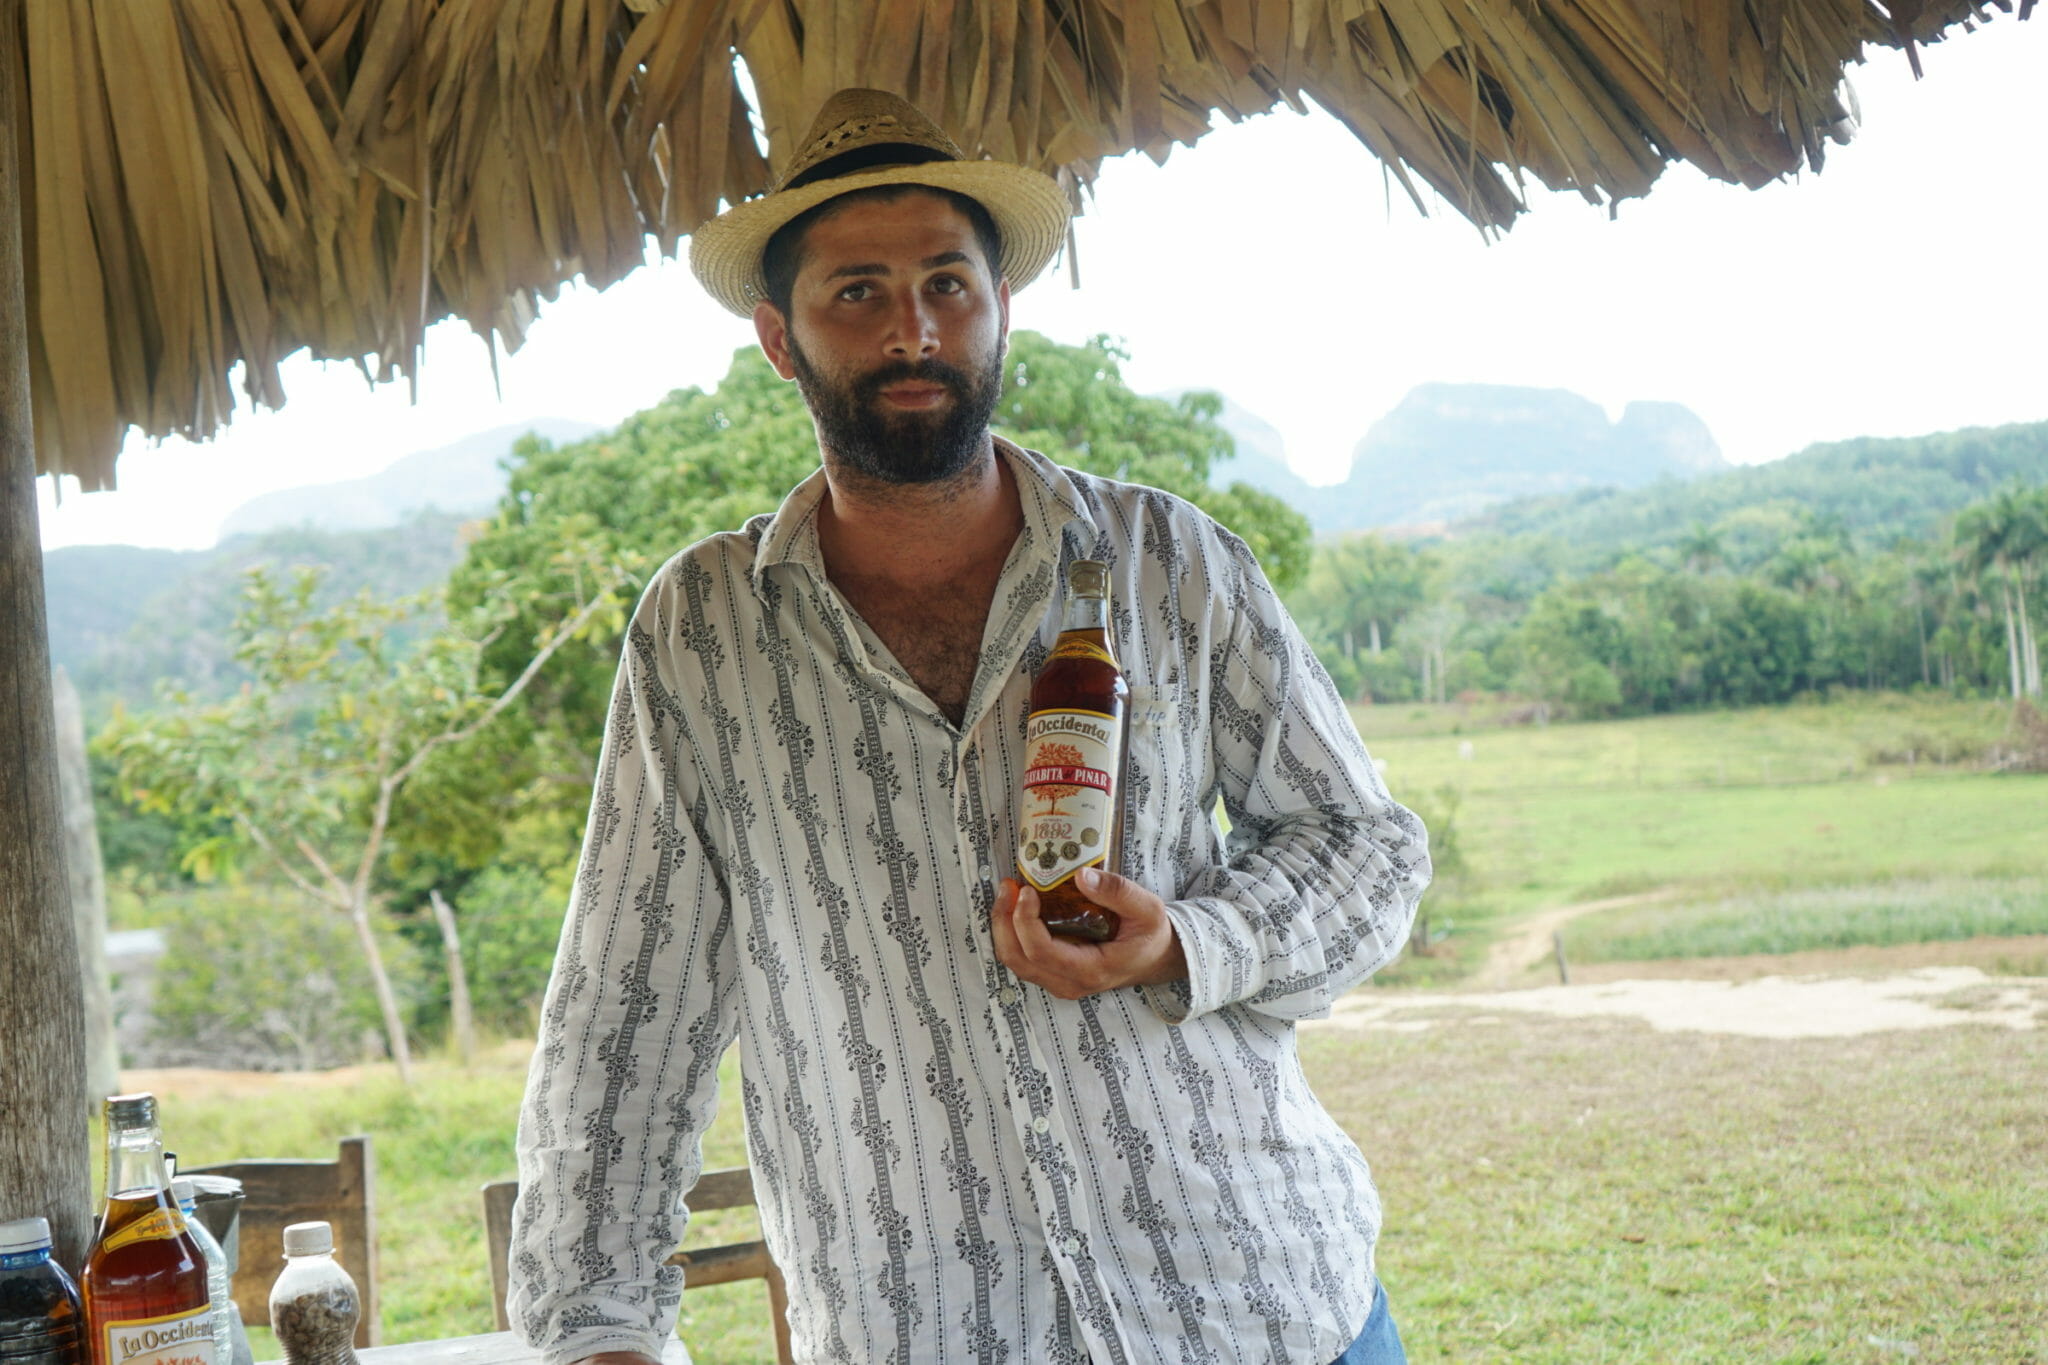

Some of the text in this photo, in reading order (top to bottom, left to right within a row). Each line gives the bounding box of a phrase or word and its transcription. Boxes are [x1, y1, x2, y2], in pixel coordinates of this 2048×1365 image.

[1074, 768, 1107, 787] PINAR
[1032, 823, 1073, 840] 1892
[118, 1335, 142, 1360] La
